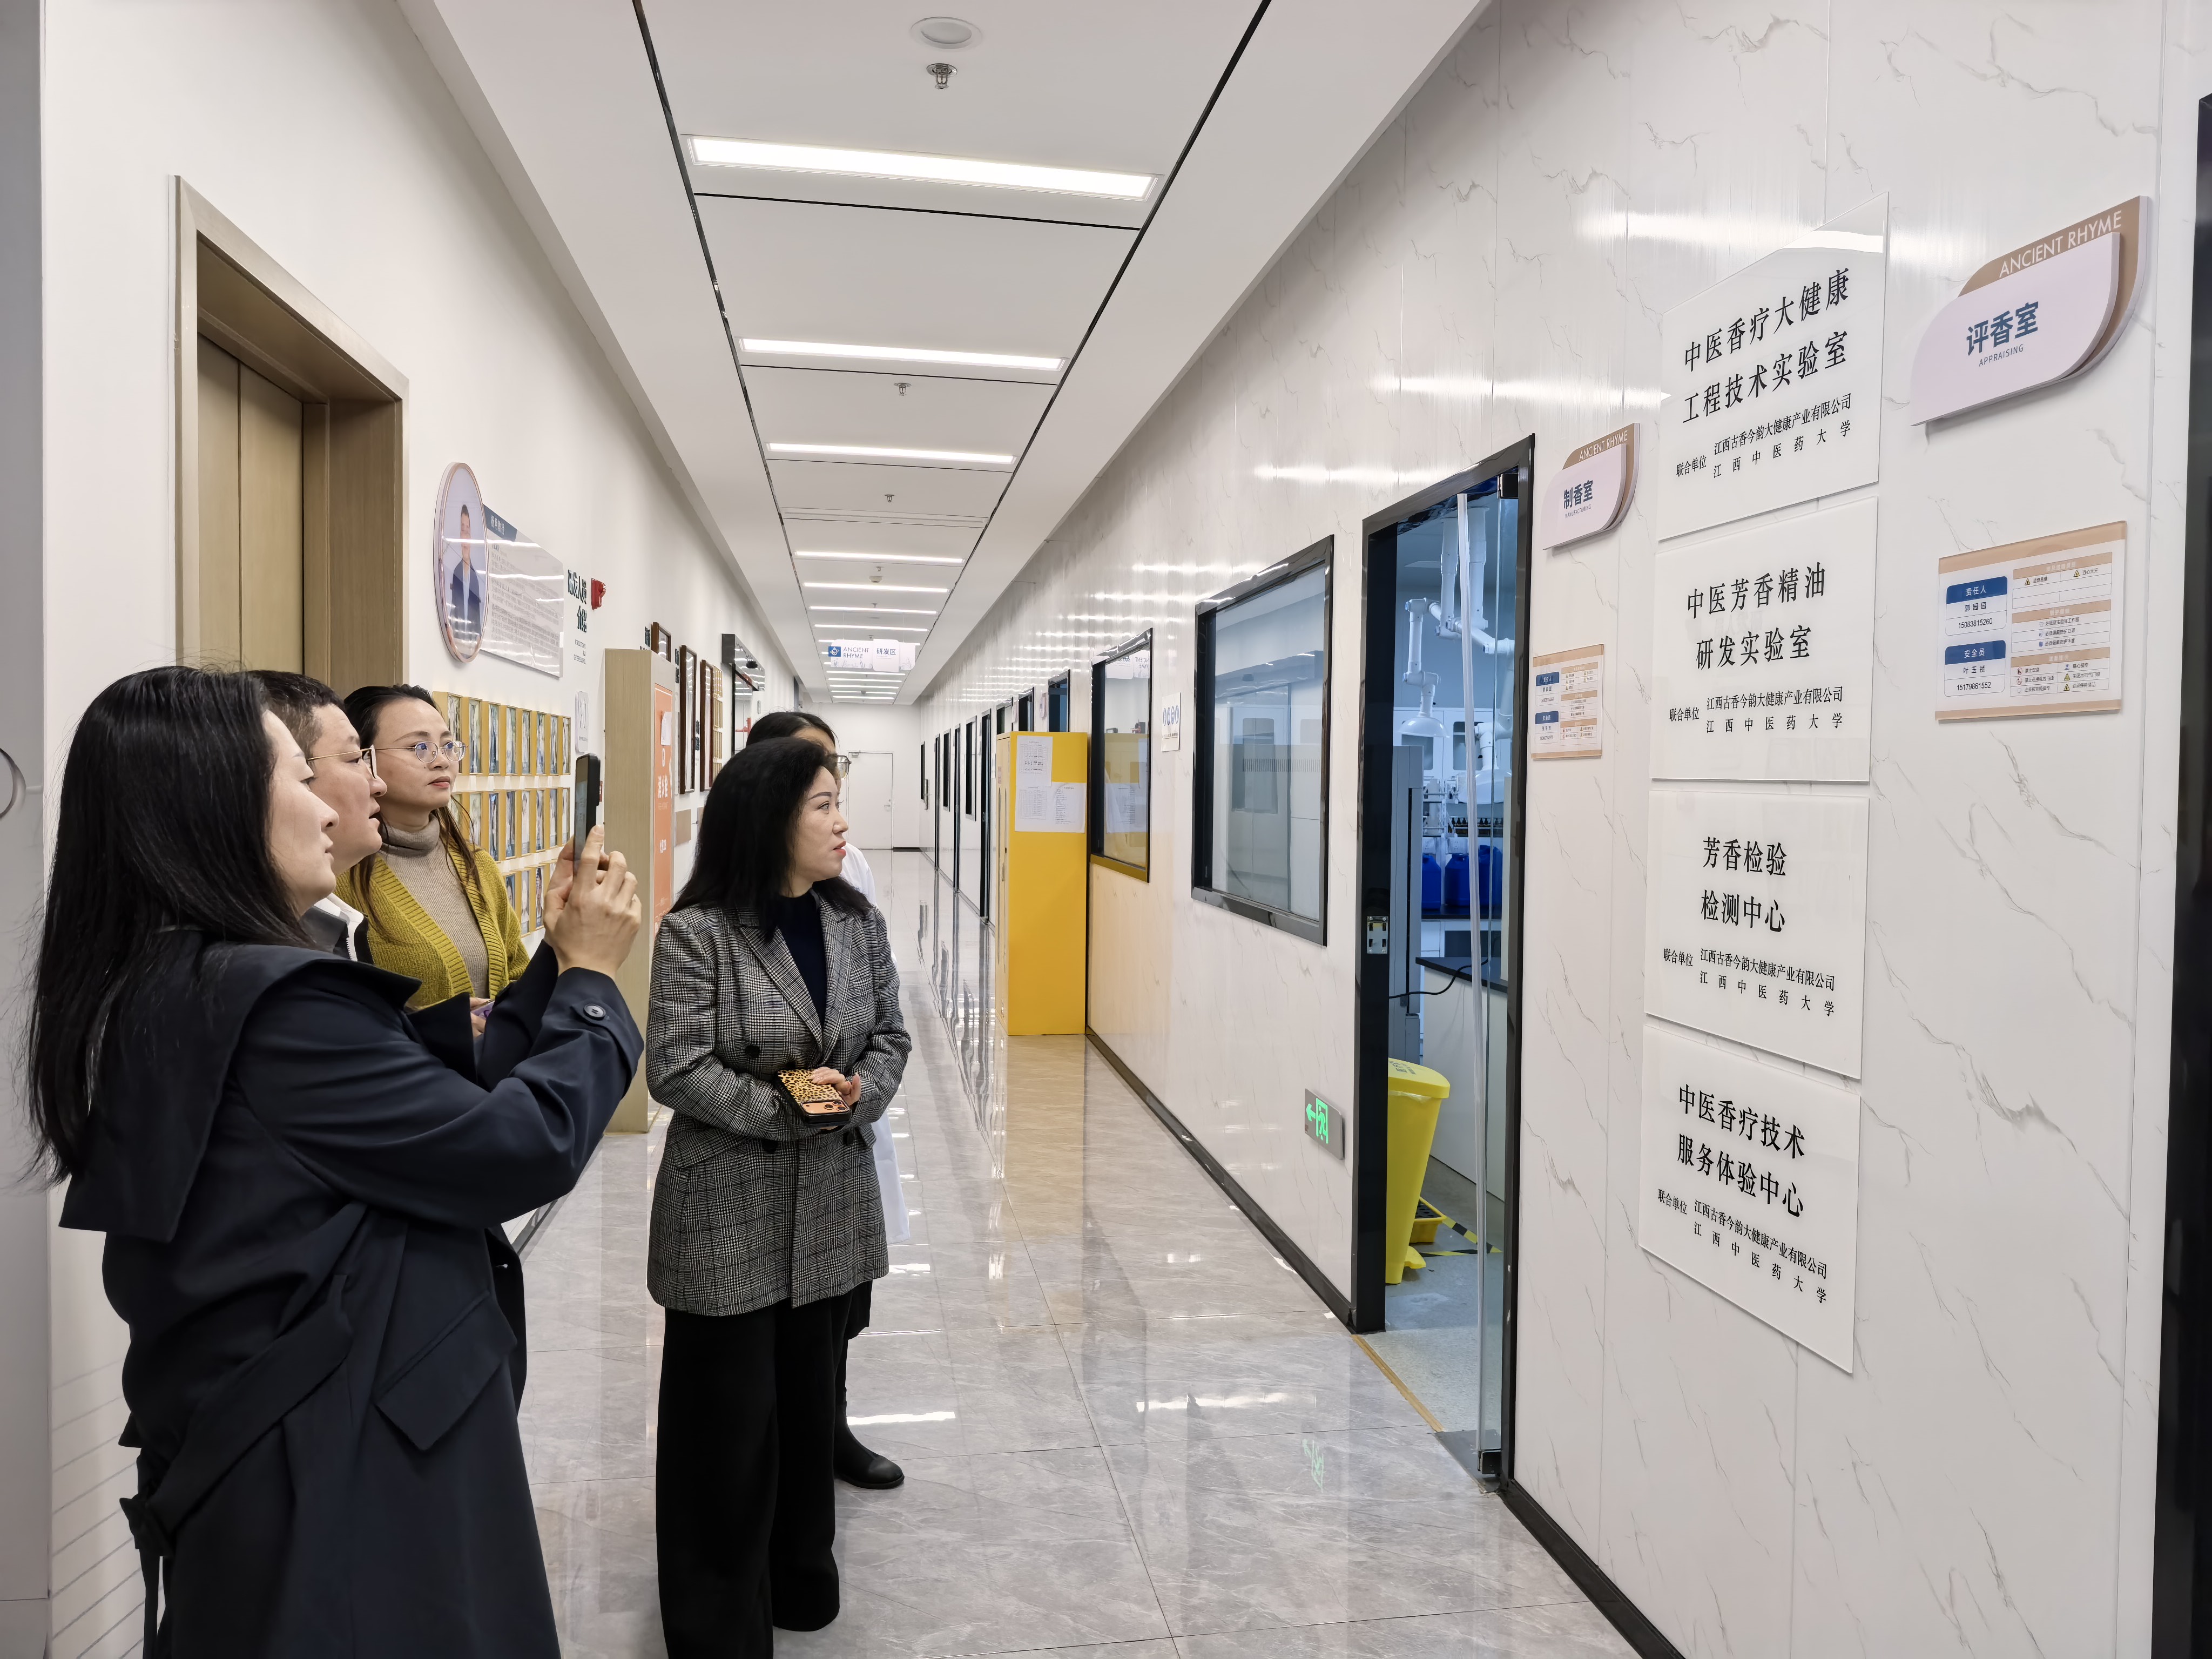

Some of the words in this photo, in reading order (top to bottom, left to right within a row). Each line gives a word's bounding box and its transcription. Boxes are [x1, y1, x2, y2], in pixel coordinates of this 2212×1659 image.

[1999, 238, 2062, 278] ANCIENT
[2068, 210, 2122, 248] RHYME
[1684, 267, 1849, 372] 中医香疗大健康
[1966, 301, 2039, 356] 评香室
[1682, 331, 1848, 423] 工程技术实验室
[1979, 343, 2024, 367] APPRAISING
[1579, 441, 1605, 461] ANCIENT
[1607, 430, 1628, 449] RHYME
[1714, 393, 1851, 456] 江西古香今韵大健康产业有限公司
[1676, 455, 1707, 477] 联合单位
[1714, 420, 1851, 478] 江西中医药大学
[1563, 480, 1593, 509] 制香室
[1687, 562, 1826, 619] 中医芳香精油
[1966, 585, 1987, 596] 责任人
[1696, 625, 1811, 670] 研发实验室
[1964, 648, 1985, 658] 安全员
[1669, 707, 1700, 722] 联合单位
[1707, 686, 1843, 711] 江西古香今韵大健康产业有限公司
[1706, 713, 1843, 733] 江西中医药大学
[1703, 836, 1787, 876] 芳香检验
[1701, 889, 1785, 933] 检测中心
[1663, 948, 1694, 967] 联合单位
[1701, 948, 1835, 992] 江西古香今韵大健康产业有限公司
[1700, 970, 1835, 1017] 江西中医药大学
[1679, 1083, 1805, 1159] 中医香疗技术
[1677, 1133, 1803, 1217] 服务体验中心
[1658, 1188, 1687, 1215] 联合单位
[1695, 1199, 1827, 1279] 江西古香今韵大健康产业有限公司
[1694, 1221, 1826, 1304] 江西中医药大学
